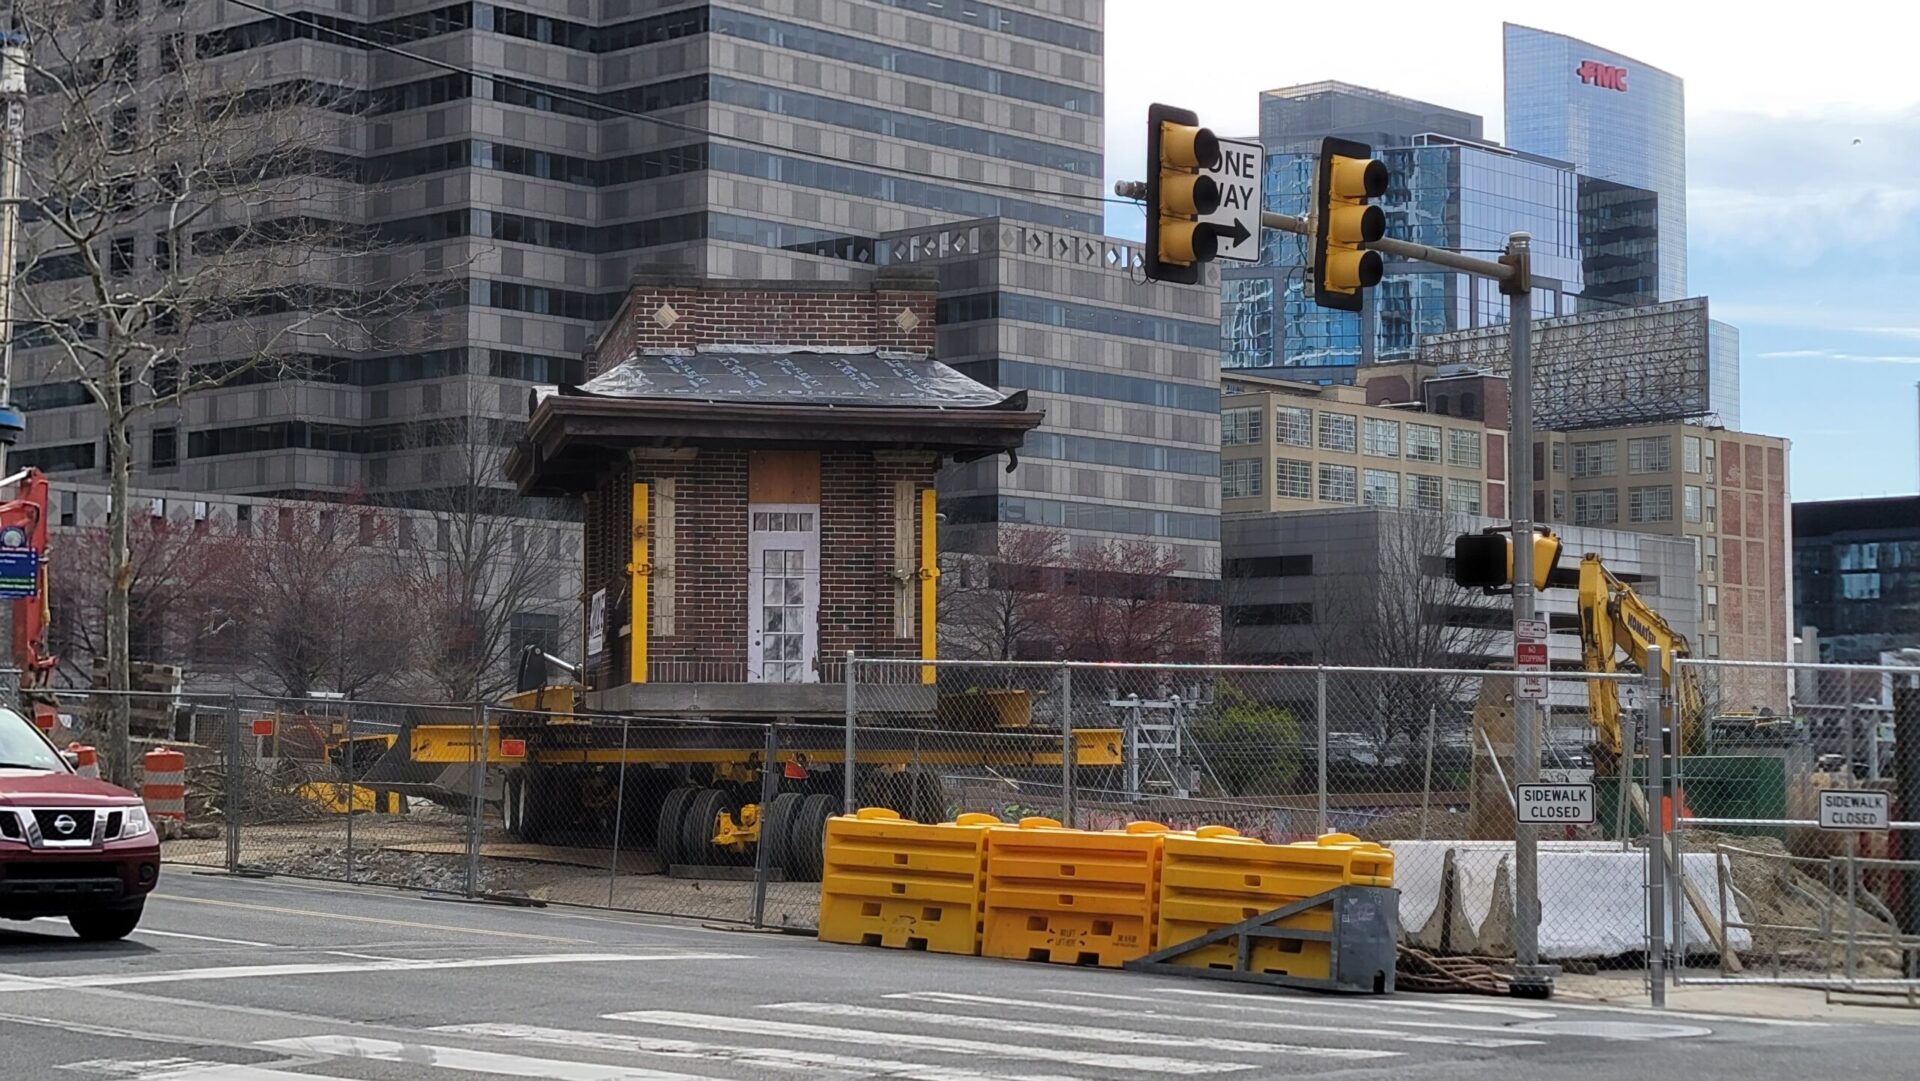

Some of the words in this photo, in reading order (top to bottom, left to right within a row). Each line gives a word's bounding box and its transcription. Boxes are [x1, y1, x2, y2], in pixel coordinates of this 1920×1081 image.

[1576, 60, 1627, 92] FMC
[1218, 182, 1254, 211] AY
[1627, 612, 1657, 645] KOMATSU
[1520, 654, 1546, 663] STOPPING
[1524, 789, 1587, 802] SIDEWALK
[1825, 795, 1883, 808] SIDEWALK
[1531, 806, 1581, 818] CLOSED
[1831, 812, 1878, 825] CLOSED
